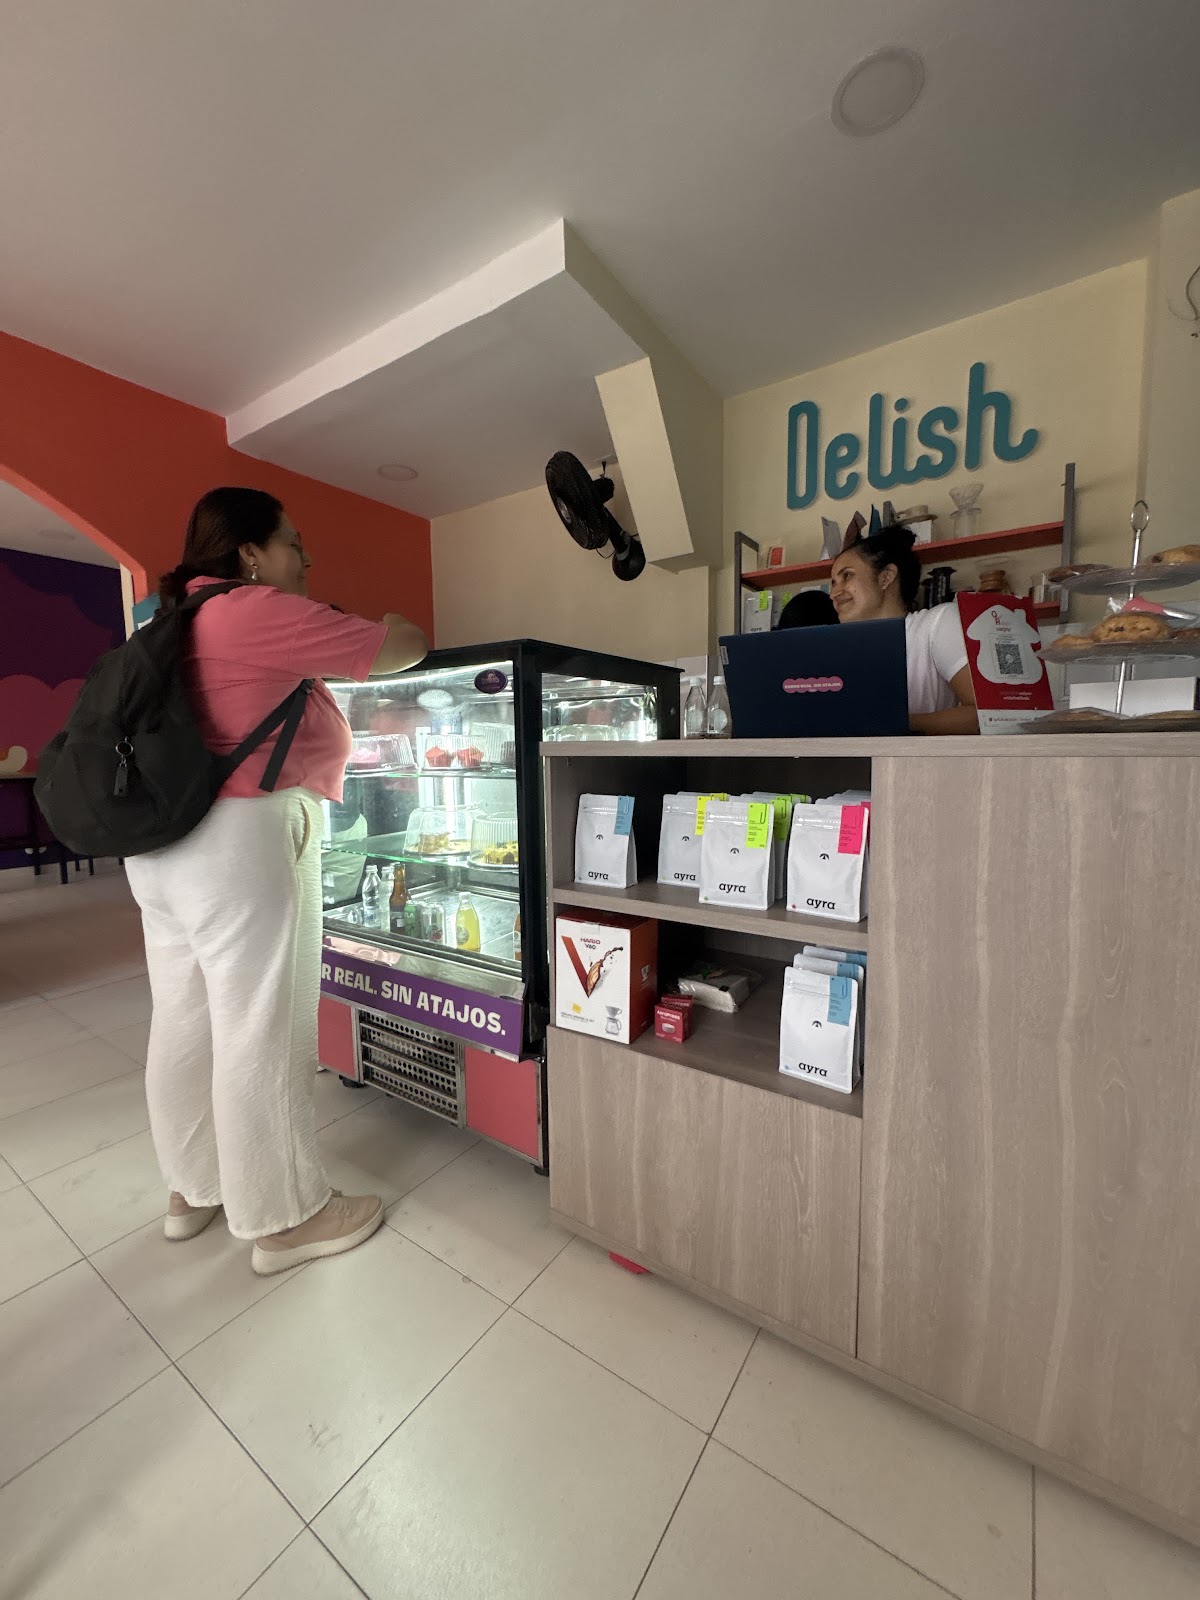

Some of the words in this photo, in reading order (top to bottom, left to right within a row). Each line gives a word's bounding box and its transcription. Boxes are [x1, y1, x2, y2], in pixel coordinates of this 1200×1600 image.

[786, 361, 1039, 511] Delish
[588, 870, 609, 881] ayra
[673, 872, 696, 882] ayra
[718, 882, 746, 895] ayra
[806, 896, 836, 911] ayra
[580, 937, 601, 945] HARIO
[334, 966, 378, 995] REAL.
[381, 980, 412, 1006] SIN
[416, 991, 506, 1036] ATAJOS.
[798, 1061, 828, 1078] ayra
